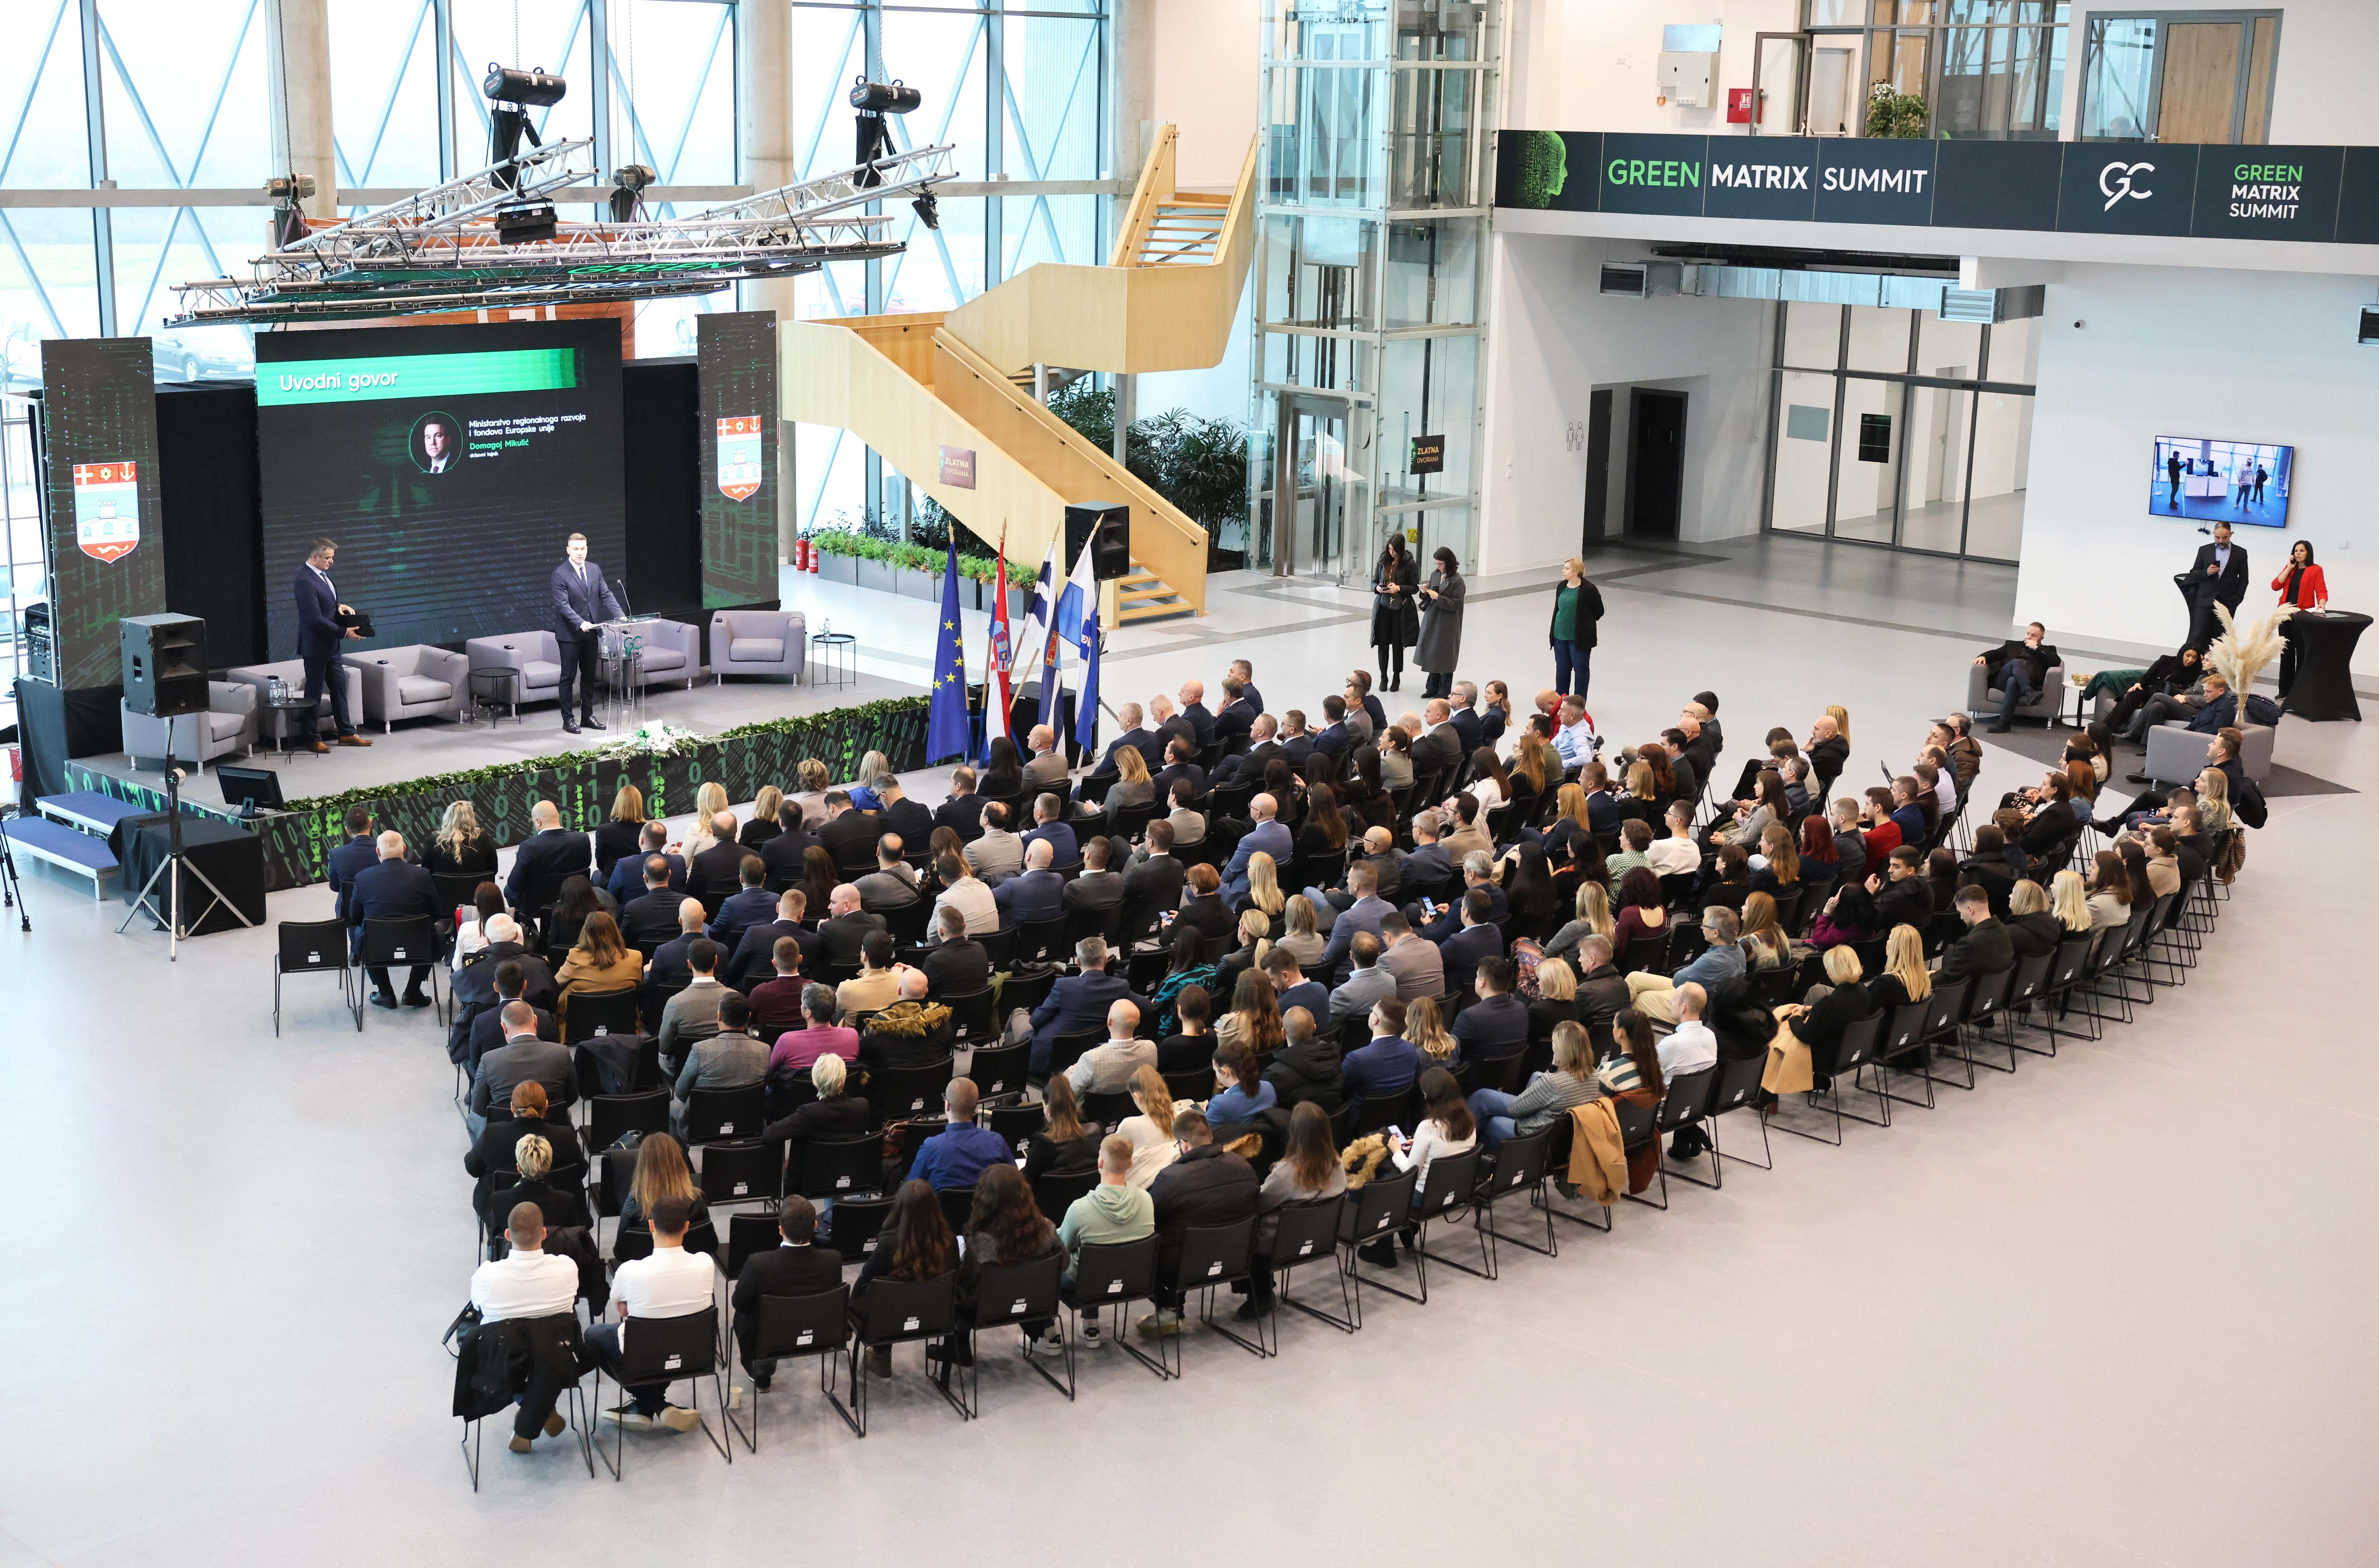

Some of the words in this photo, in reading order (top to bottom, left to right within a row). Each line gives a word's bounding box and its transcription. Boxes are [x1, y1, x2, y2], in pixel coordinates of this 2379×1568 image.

[1608, 159, 1700, 188] GREEN
[1711, 164, 1809, 189] MATRIX
[1822, 167, 1928, 193] SUMMIT
[2234, 164, 2303, 182] GREEN
[2231, 184, 2301, 201] MATRIX
[2229, 203, 2299, 219] SUMMIT
[567, 261, 742, 274] GREEN
[280, 372, 341, 391] Uvodni
[348, 373, 399, 393] govor
[469, 418, 511, 428] Ministarstvo
[513, 416, 559, 426] regionalnoga
[561, 413, 586, 422] razvoja
[469, 429, 472, 437] i
[473, 428, 503, 437] fondova
[505, 425, 537, 434] Europske
[539, 424, 555, 433] unije
[469, 440, 503, 450] Domagoj
[505, 438, 529, 447] Mikulić
[1417, 446, 1439, 455] ZLATNA
[945, 457, 969, 469] ZLATNA
[945, 467, 969, 478] DVORANA
